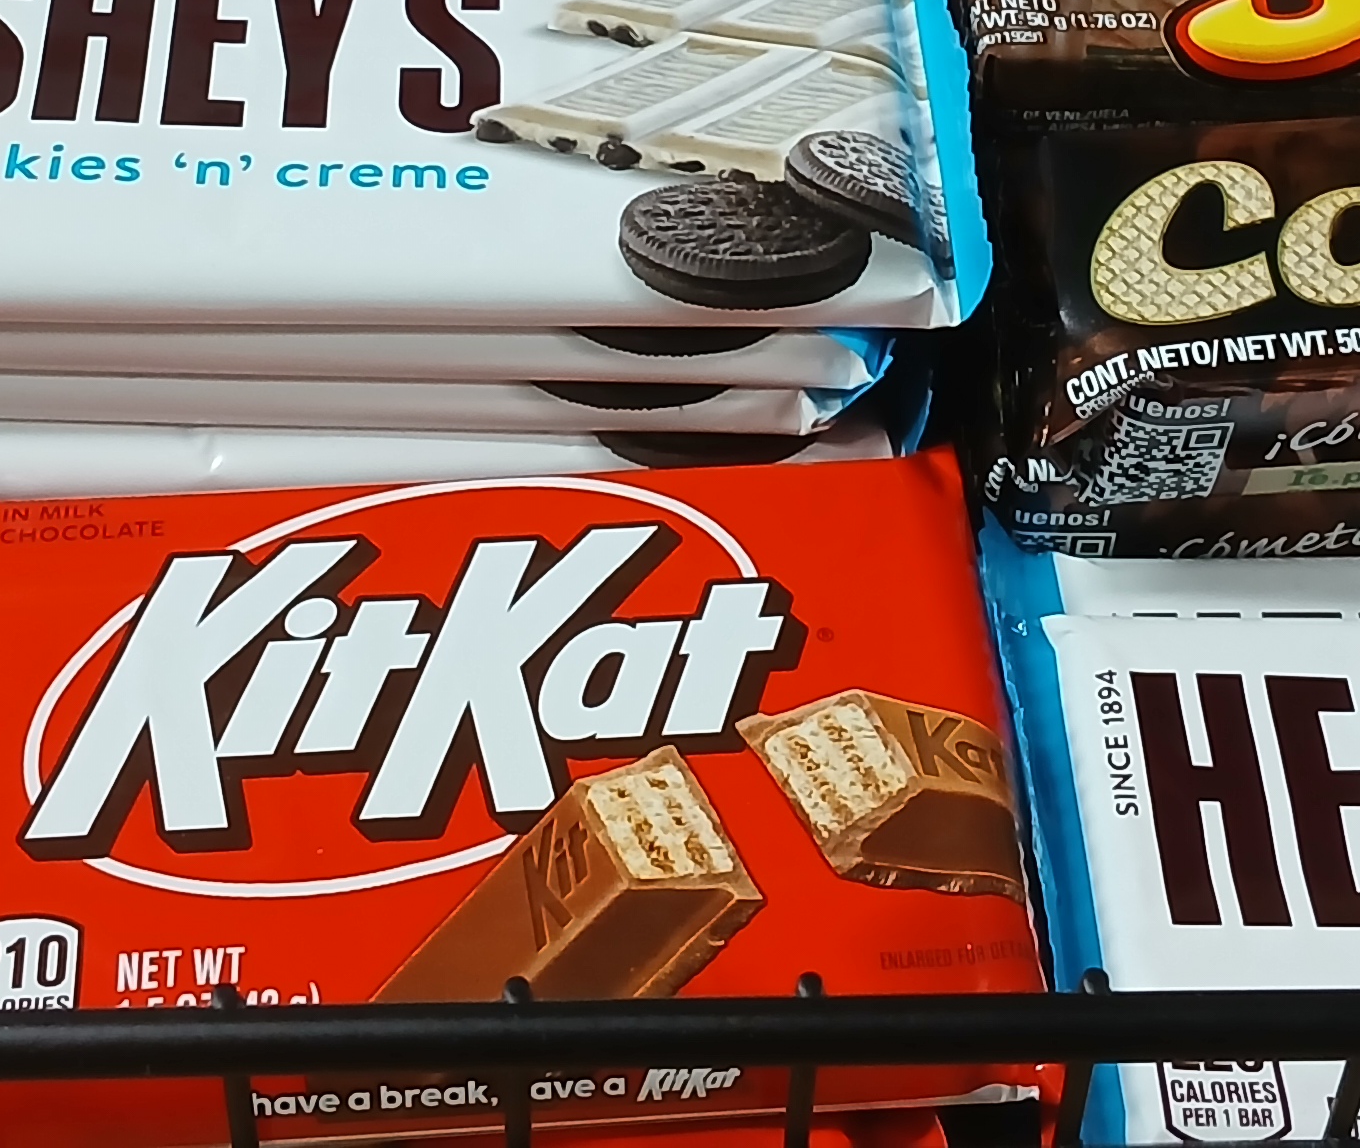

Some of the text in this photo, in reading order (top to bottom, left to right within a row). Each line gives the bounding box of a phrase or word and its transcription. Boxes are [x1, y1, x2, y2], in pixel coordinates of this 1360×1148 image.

[1121, 12, 1157, 30] OZ)
[276, 157, 491, 193] creme
[1066, 352, 1137, 406] CONT.
[1138, 338, 1221, 376] NETO/
[1226, 333, 1278, 365] NET
[1280, 330, 1334, 360] WT.
[0, 520, 166, 544] CHOCOLATE
[1, 501, 106, 522] IN MILK
[20, 522, 798, 854] KitKat
[1095, 668, 1140, 817] SINCE 1894
[520, 815, 594, 953] Kit
[116, 946, 246, 993] NET WT
[251, 1067, 742, 1117] have a break, a KitKat
[1171, 1079, 1278, 1104] CALORIES
[1182, 1107, 1275, 1128] PER BAR
